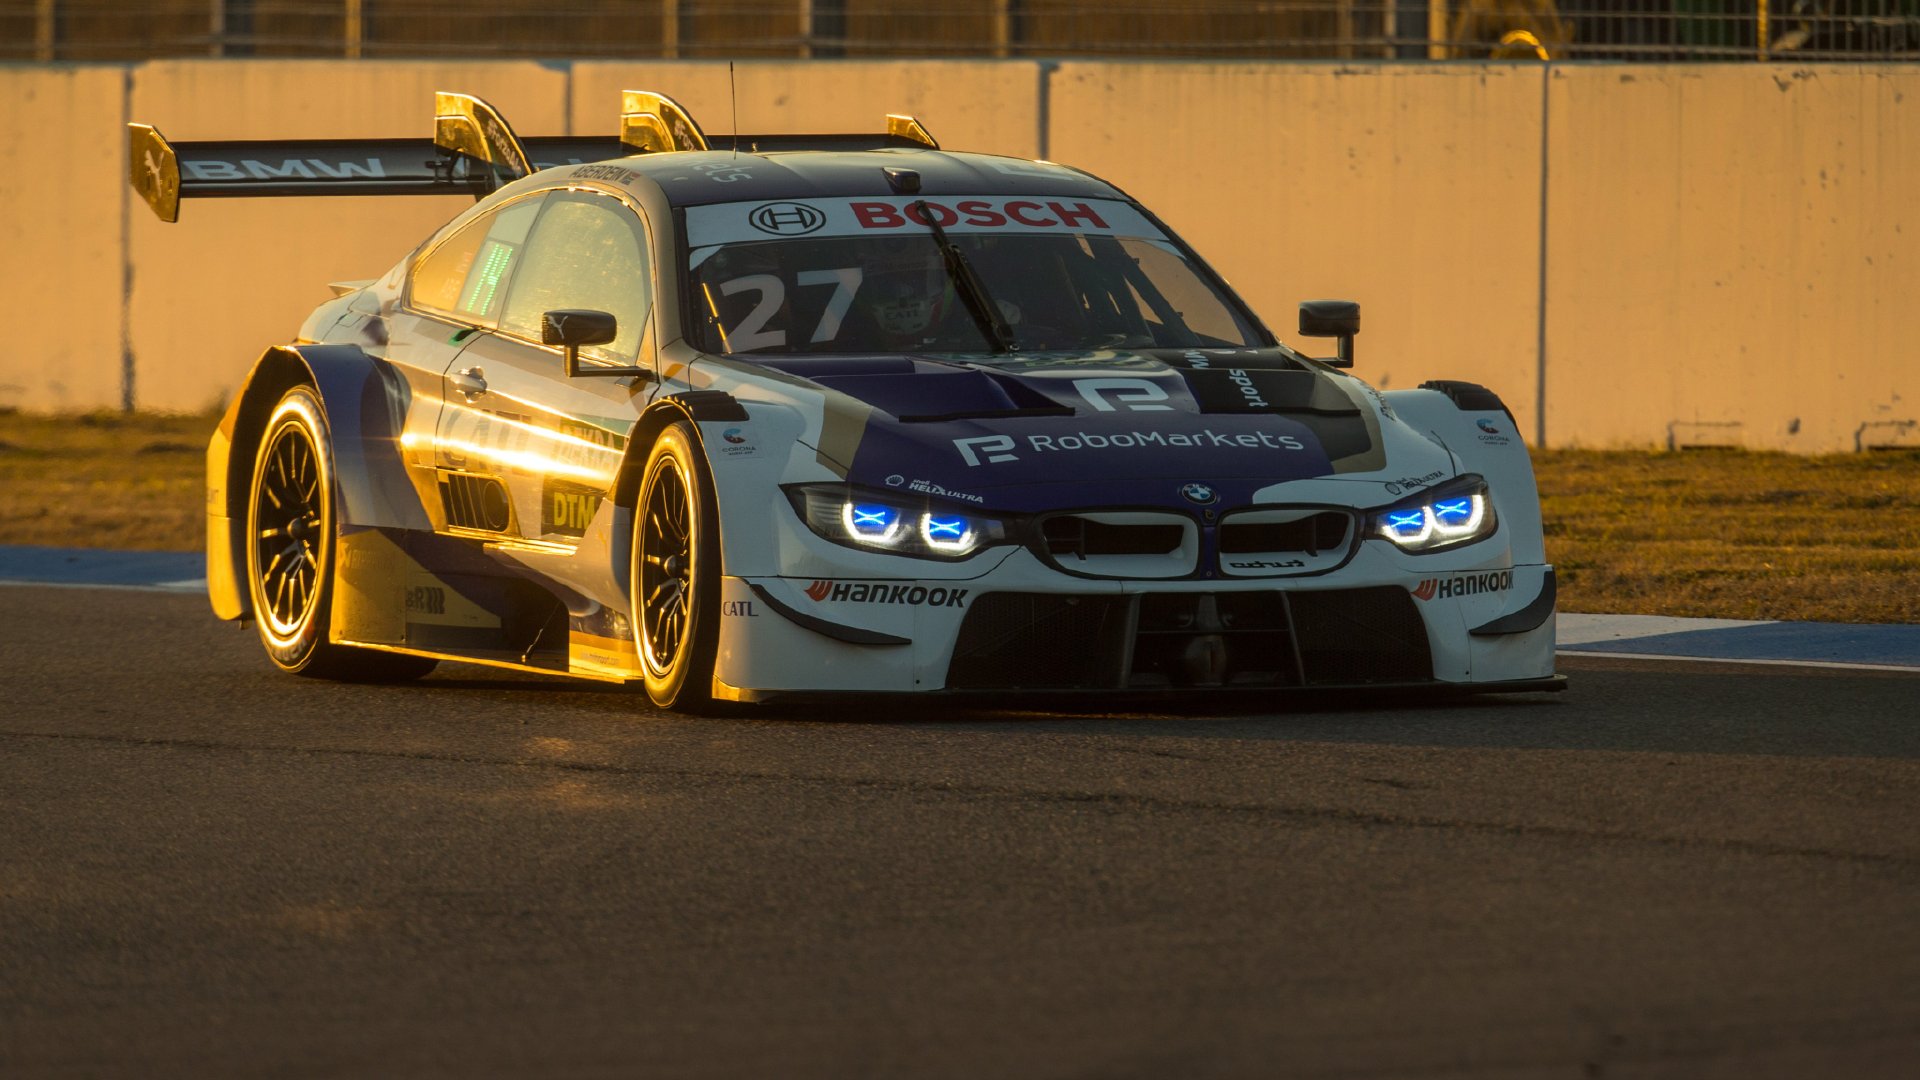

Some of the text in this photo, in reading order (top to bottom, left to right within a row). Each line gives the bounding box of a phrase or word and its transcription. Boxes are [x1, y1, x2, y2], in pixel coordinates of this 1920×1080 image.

[182, 157, 386, 180] BMW
[849, 200, 1111, 229] BOSCH
[720, 267, 864, 353] 27
[1027, 429, 1304, 452] RoboMarkets
[947, 490, 984, 503] ULTRA
[553, 492, 596, 530] DTM
[723, 601, 759, 617] CATL
